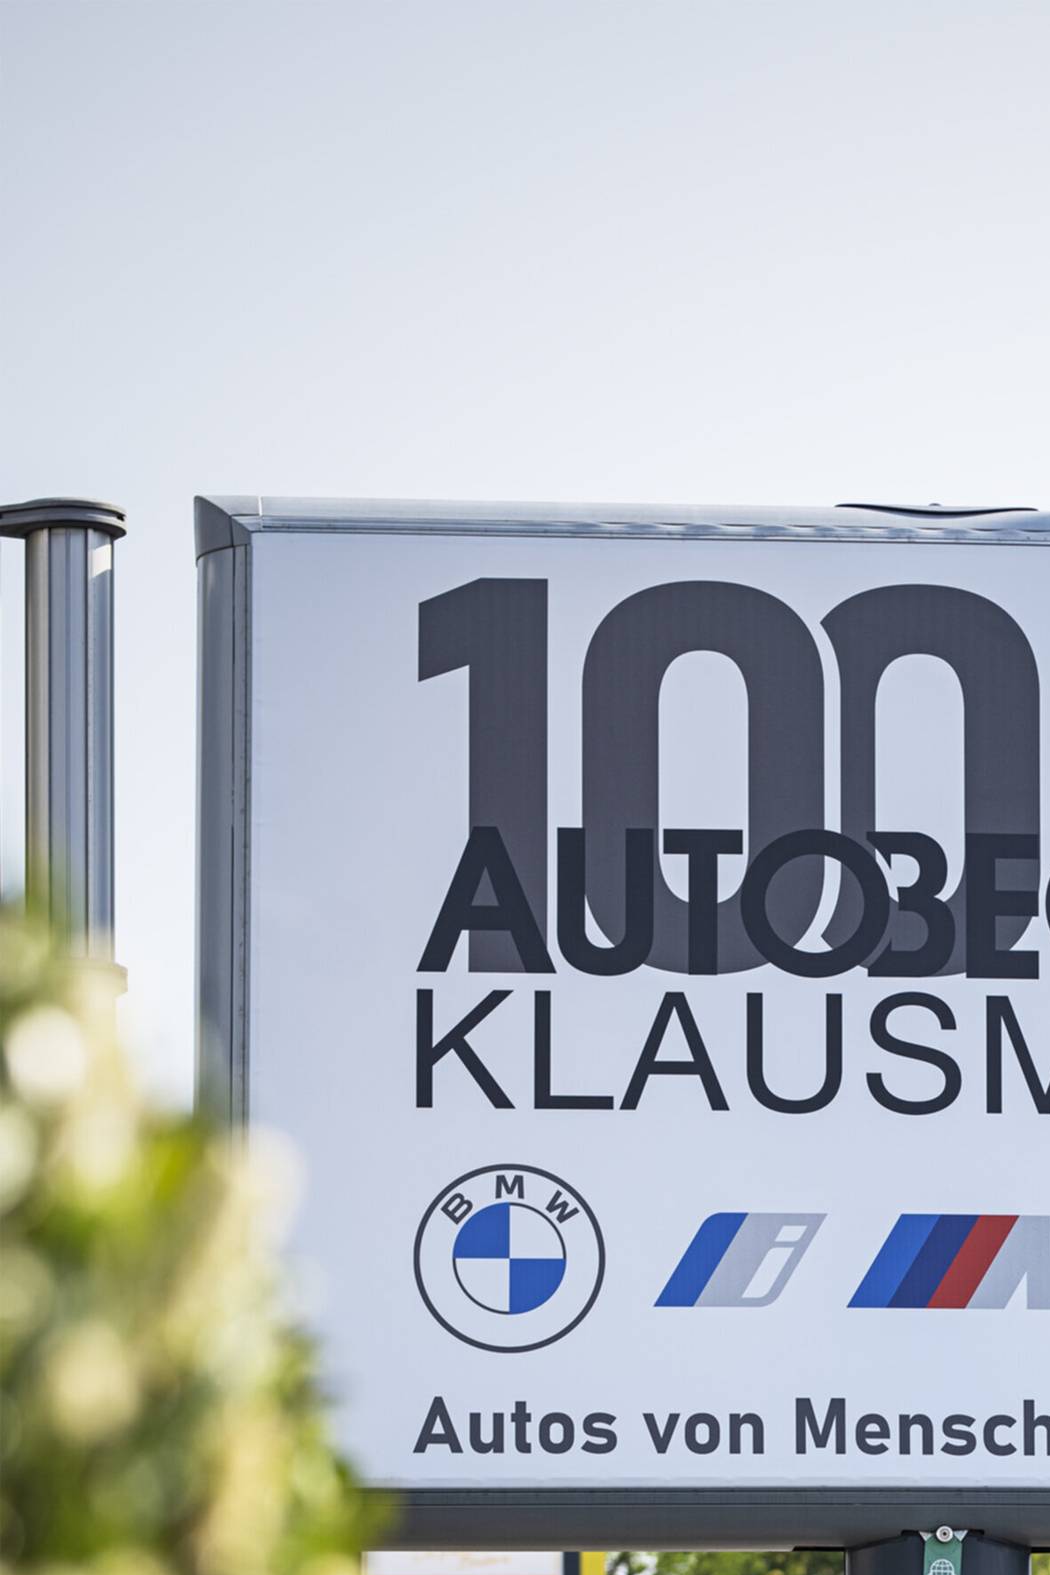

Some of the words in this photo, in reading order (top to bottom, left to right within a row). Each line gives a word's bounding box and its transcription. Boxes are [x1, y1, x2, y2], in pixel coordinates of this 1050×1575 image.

[418, 577, 1041, 976] 100
[440, 1173, 580, 1225] BMW
[412, 1395, 618, 1455] Autos
[641, 1411, 765, 1455] von
